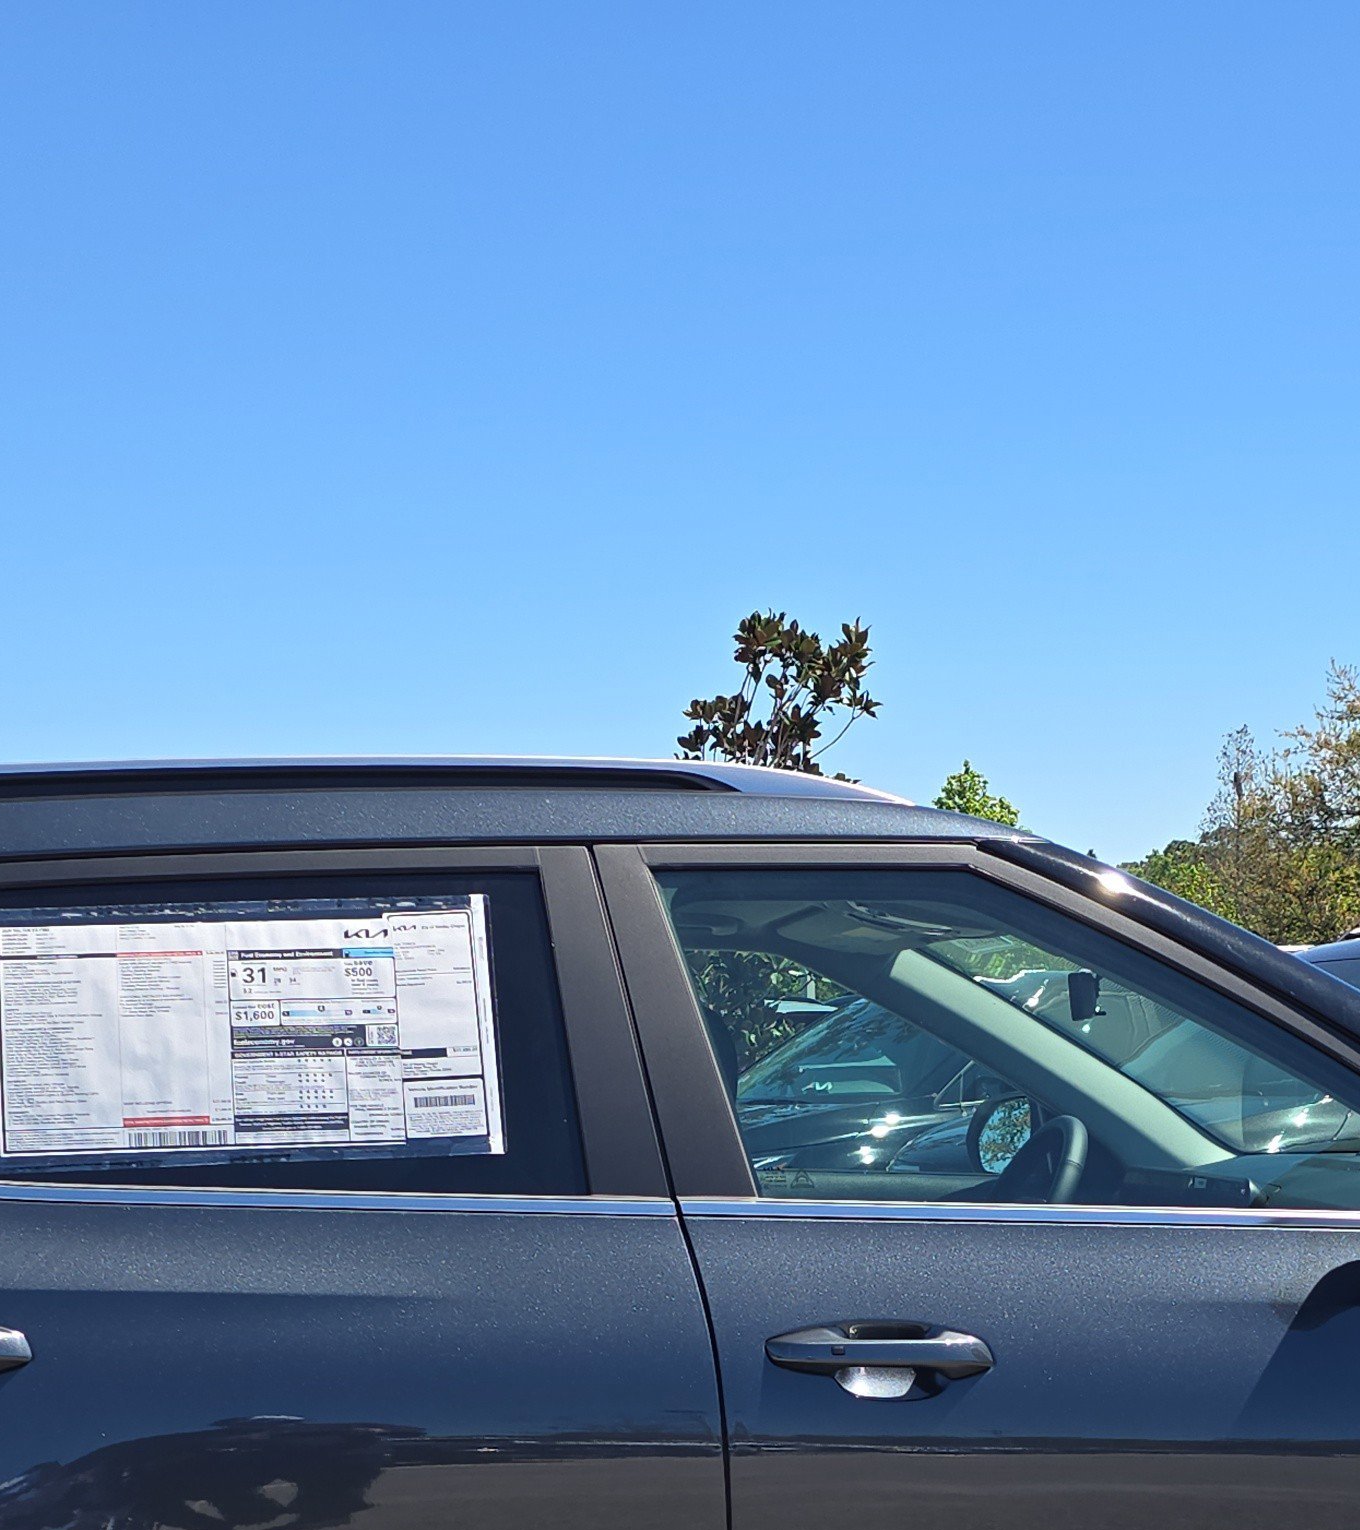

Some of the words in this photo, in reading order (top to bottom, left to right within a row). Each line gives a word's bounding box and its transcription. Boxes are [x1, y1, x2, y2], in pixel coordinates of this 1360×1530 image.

[343, 928, 388, 939] KIA
[255, 951, 282, 959] Economy
[296, 950, 334, 958] Environment
[242, 967, 267, 984] 31
[344, 967, 373, 977] $500
[235, 1010, 274, 1021] $1,600
